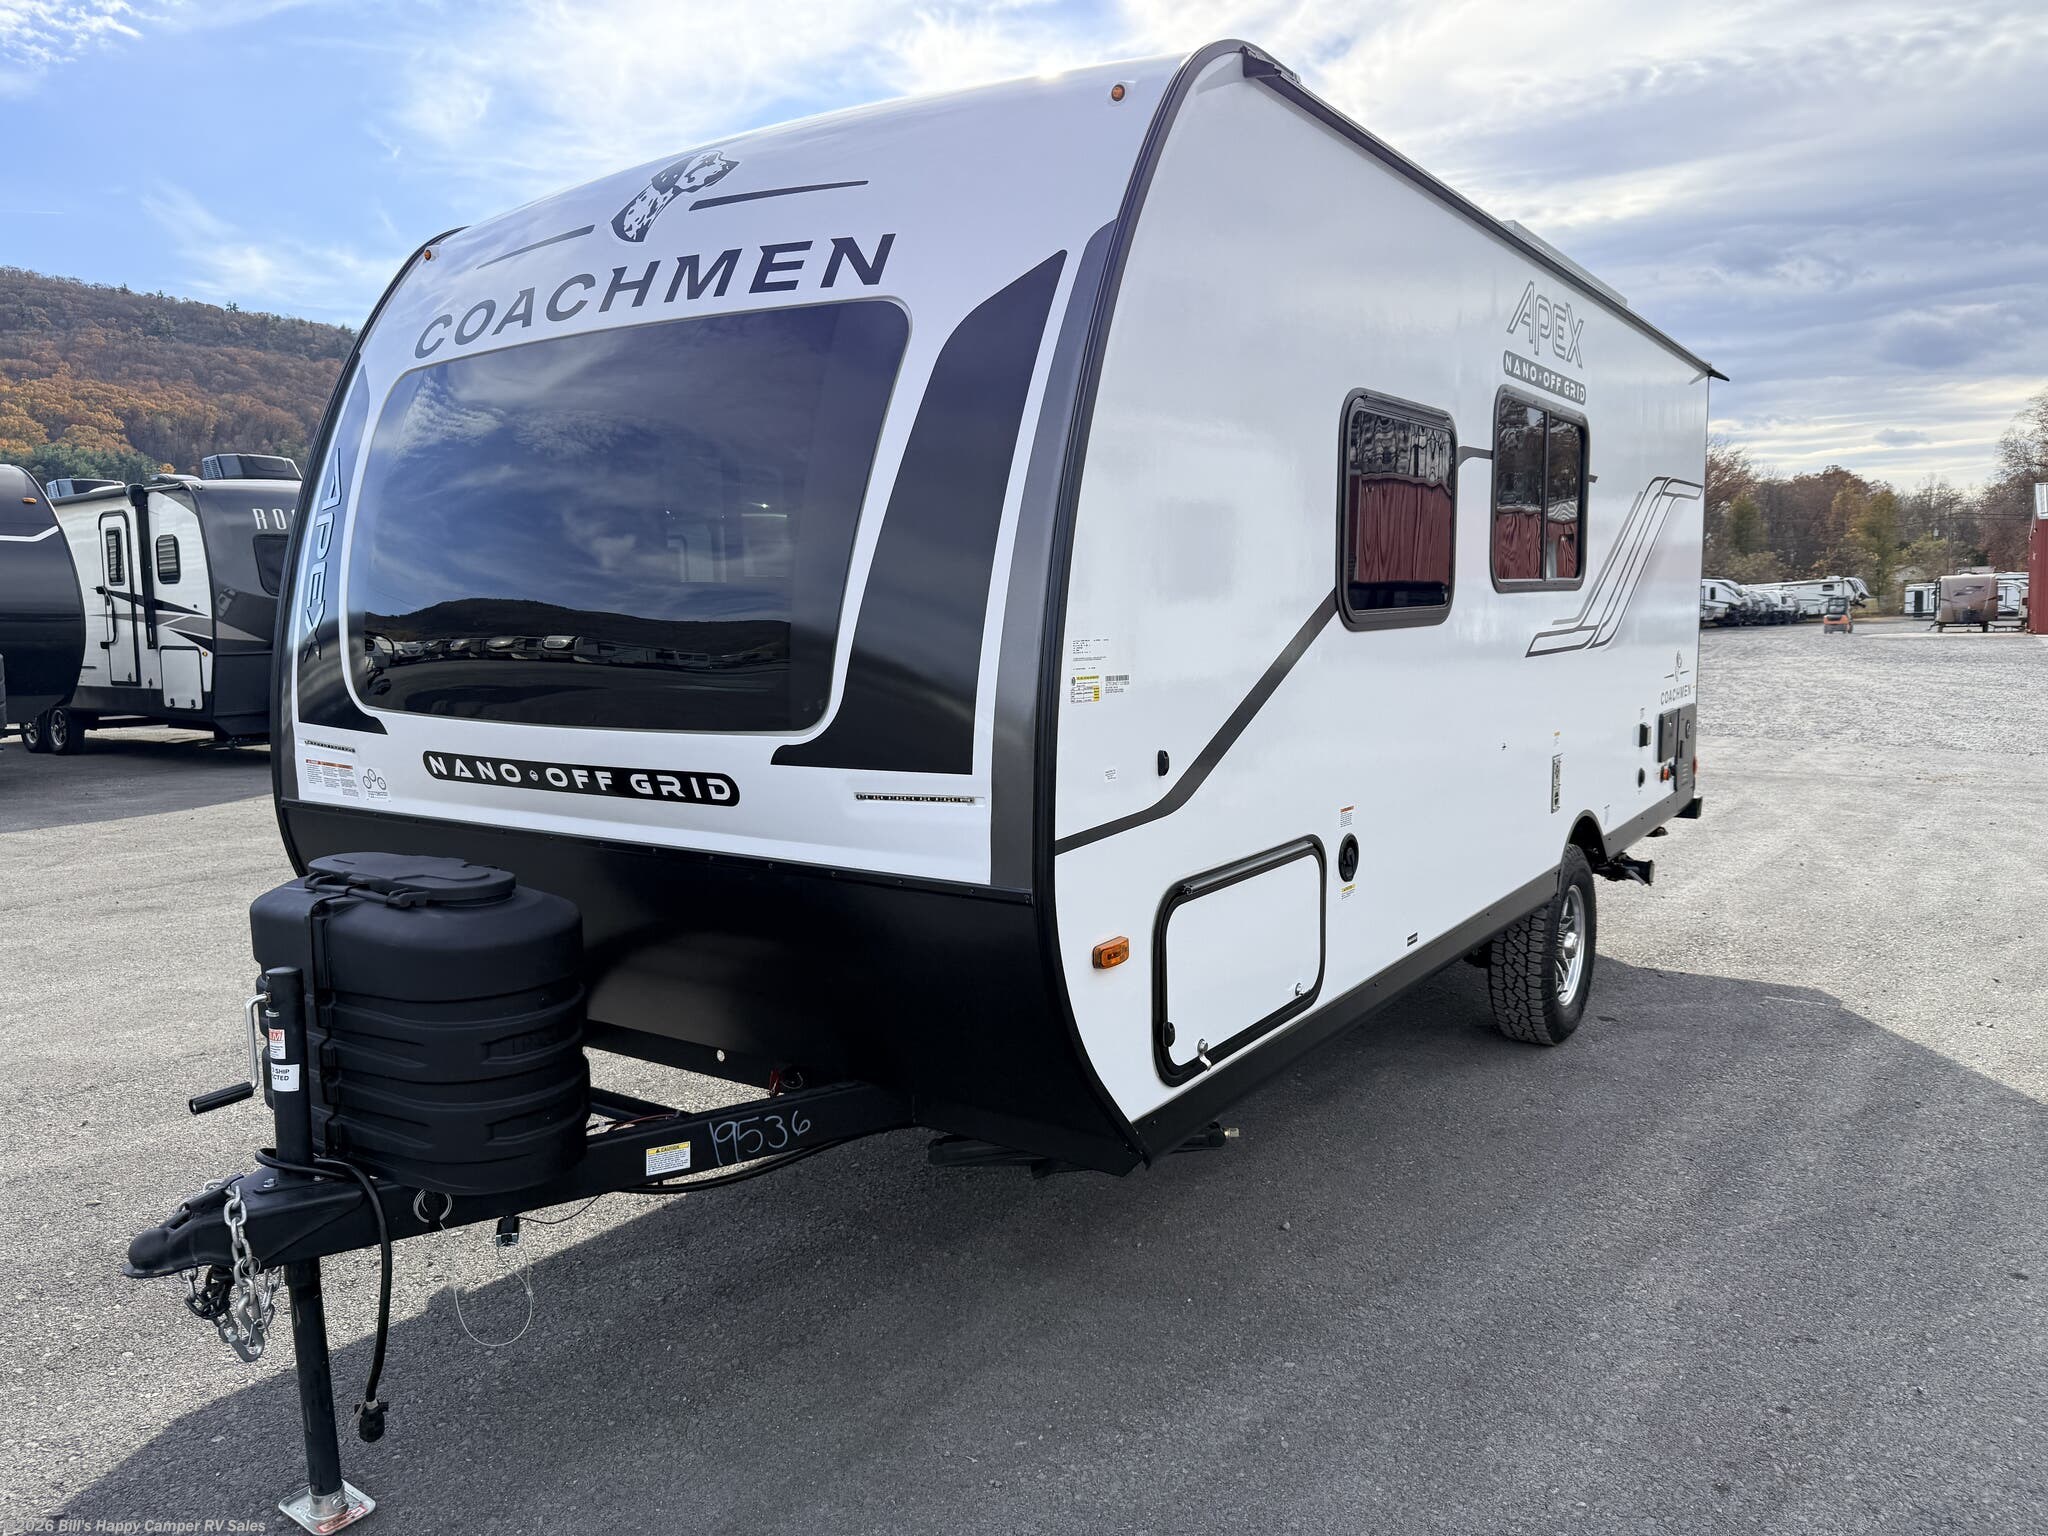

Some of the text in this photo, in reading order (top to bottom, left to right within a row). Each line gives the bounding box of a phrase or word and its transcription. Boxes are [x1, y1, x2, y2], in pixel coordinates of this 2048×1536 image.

[414, 233, 896, 359] COACHMEN
[1506, 280, 1584, 369] APEX
[1505, 354, 1585, 402] NANO OFF GRID
[252, 508, 296, 530] RO
[304, 448, 342, 663] APEX
[1660, 684, 1691, 706] COACHMEN
[428, 755, 731, 800] NANO OFF GRID
[709, 1110, 811, 1166] 19536
